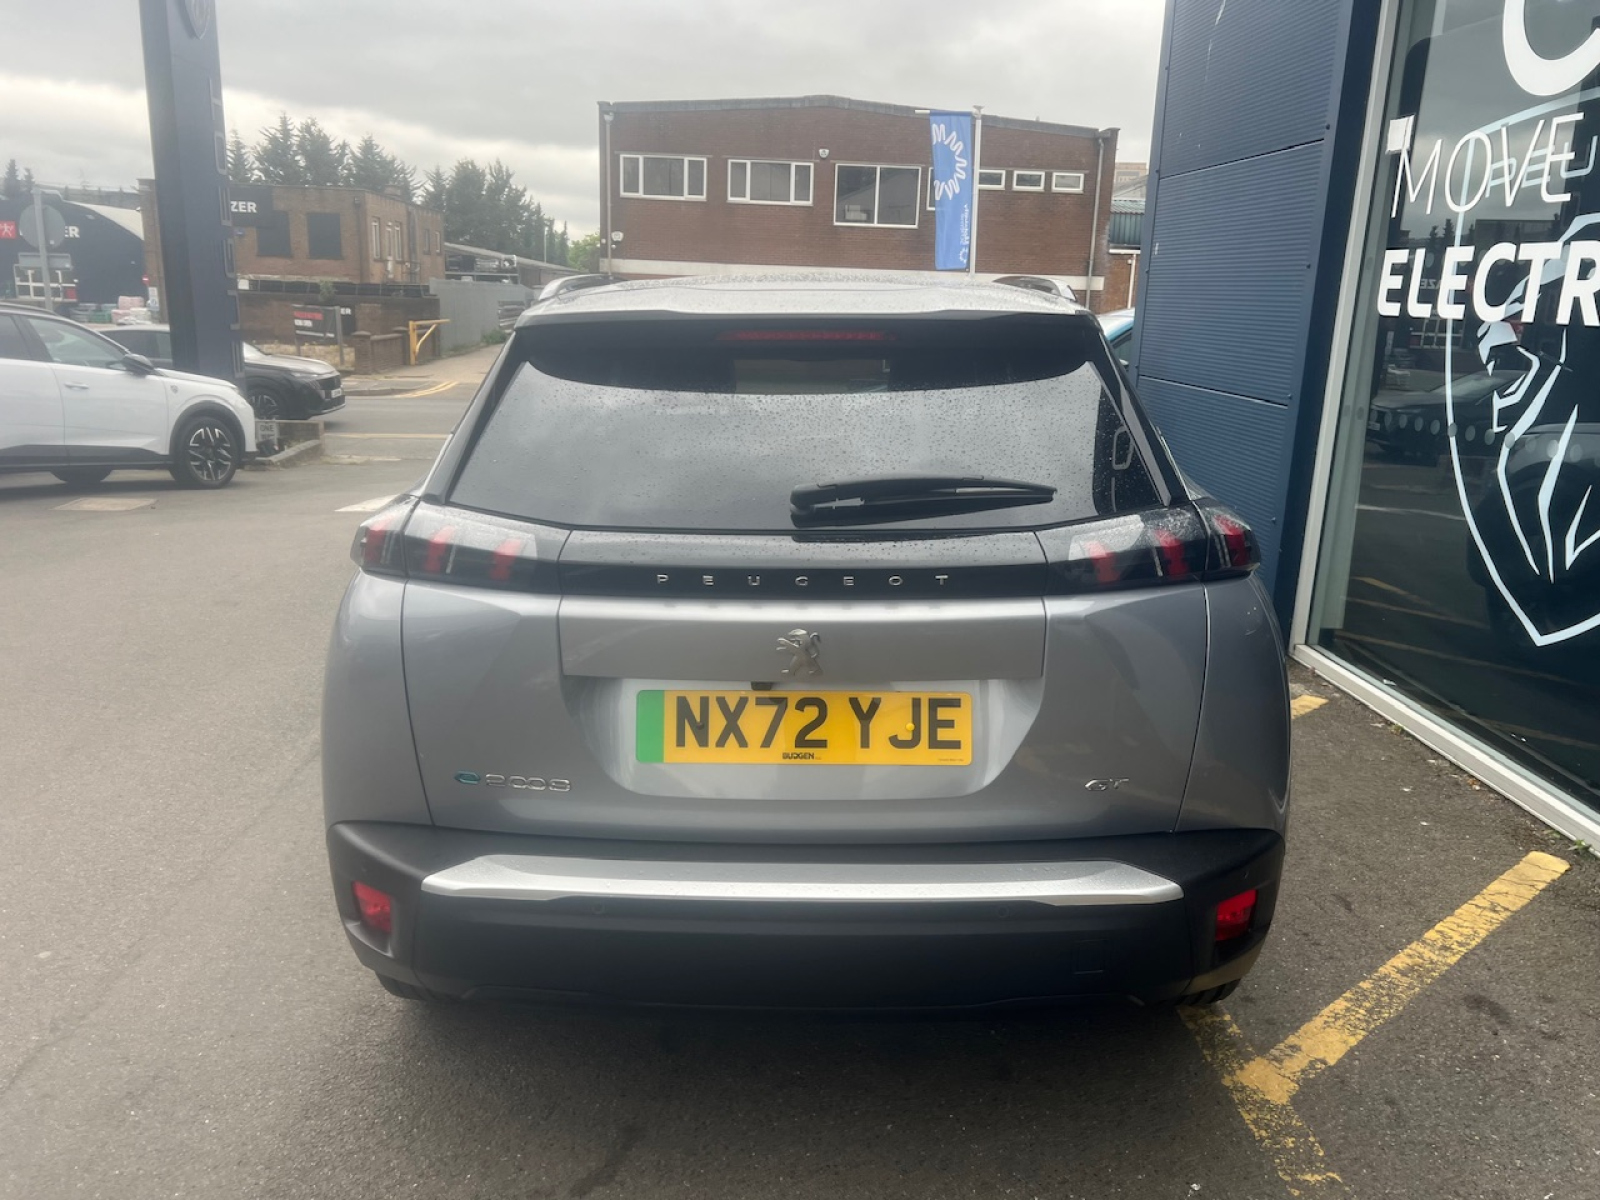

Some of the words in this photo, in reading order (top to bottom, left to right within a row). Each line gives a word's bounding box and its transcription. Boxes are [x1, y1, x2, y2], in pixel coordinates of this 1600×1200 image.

[1390, 112, 1585, 219] MOVE
[1377, 240, 1600, 327] ELECTR
[656, 574, 949, 586] PEUGEOT
[675, 695, 828, 750] NX72
[848, 696, 962, 751] YJE
